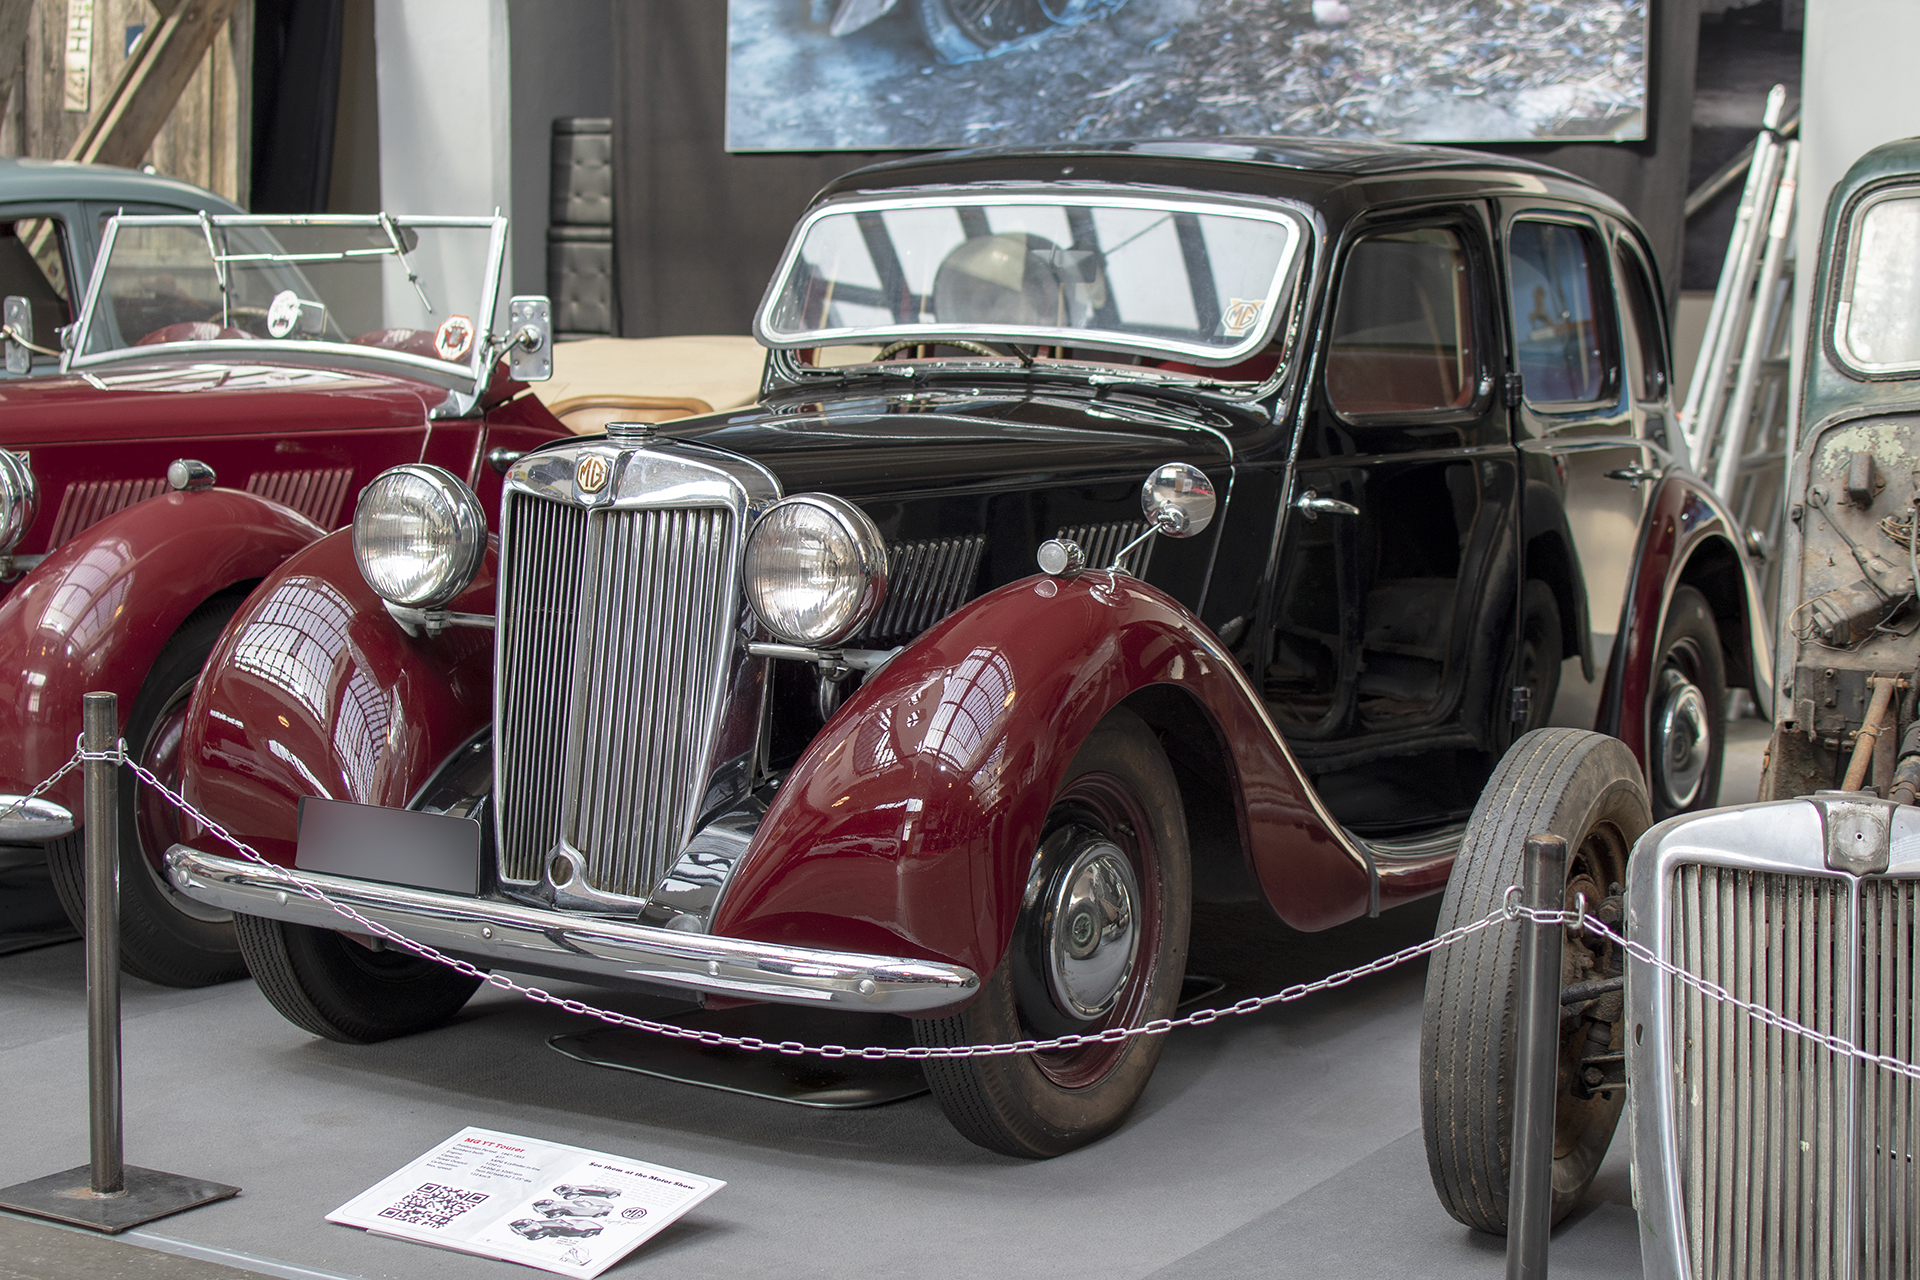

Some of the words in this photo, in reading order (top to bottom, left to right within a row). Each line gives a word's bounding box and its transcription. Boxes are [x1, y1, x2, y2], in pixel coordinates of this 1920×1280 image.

[66, 67, 86, 104] 177
[1228, 305, 1256, 327] MG
[579, 458, 604, 488] MG
[496, 1143, 525, 1152] Tourer
[649, 1175, 672, 1185] Motor
[673, 1181, 696, 1190] Show
[624, 1208, 645, 1219] MG
